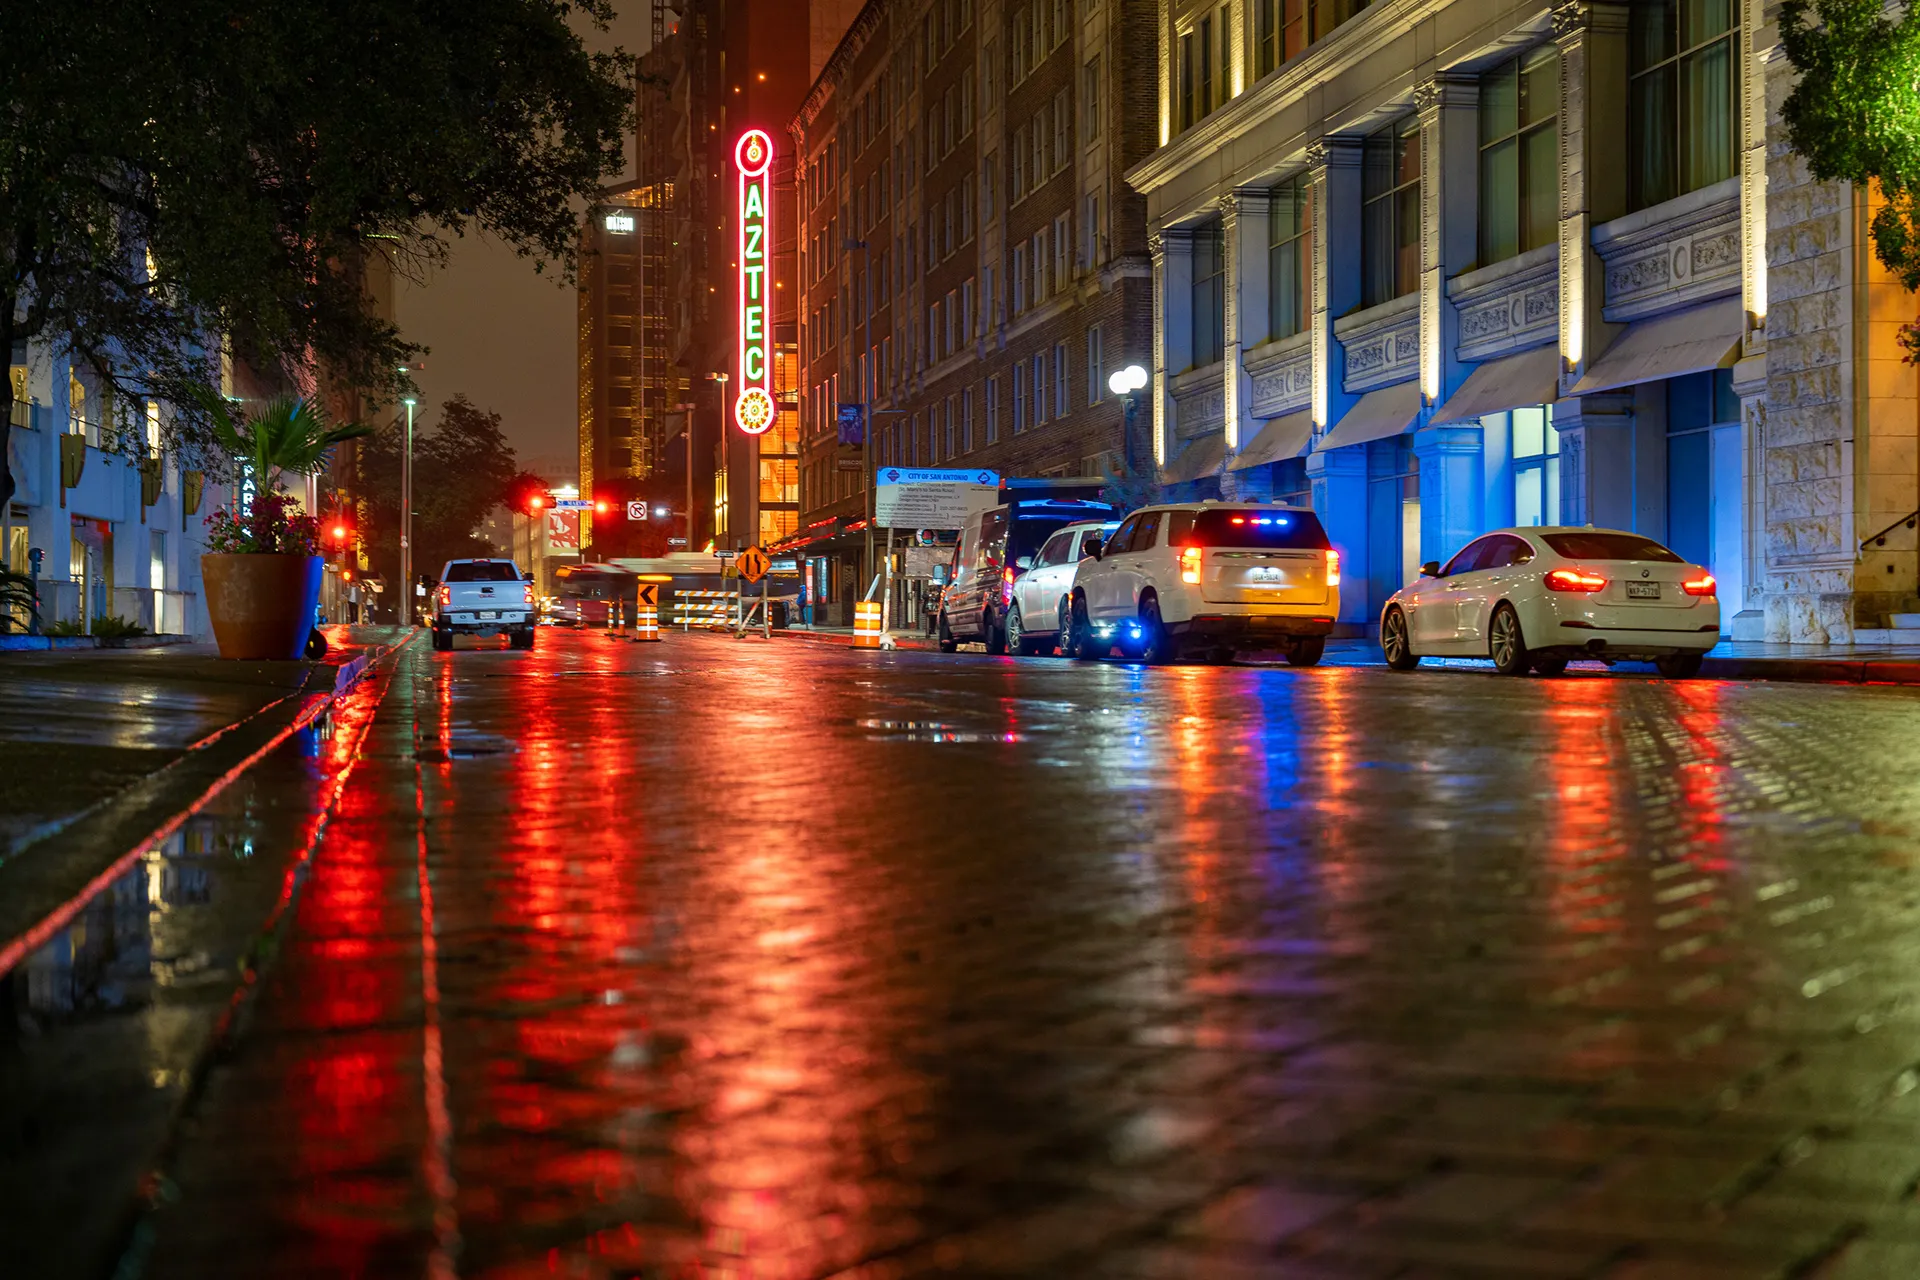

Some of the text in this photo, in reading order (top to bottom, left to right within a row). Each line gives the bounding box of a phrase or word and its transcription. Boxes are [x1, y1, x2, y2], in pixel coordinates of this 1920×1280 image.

[744, 184, 764, 381] AZTEC
[908, 472, 921, 480] CITY
[930, 473, 942, 481] SAN
[943, 473, 969, 481] ANTONIO
